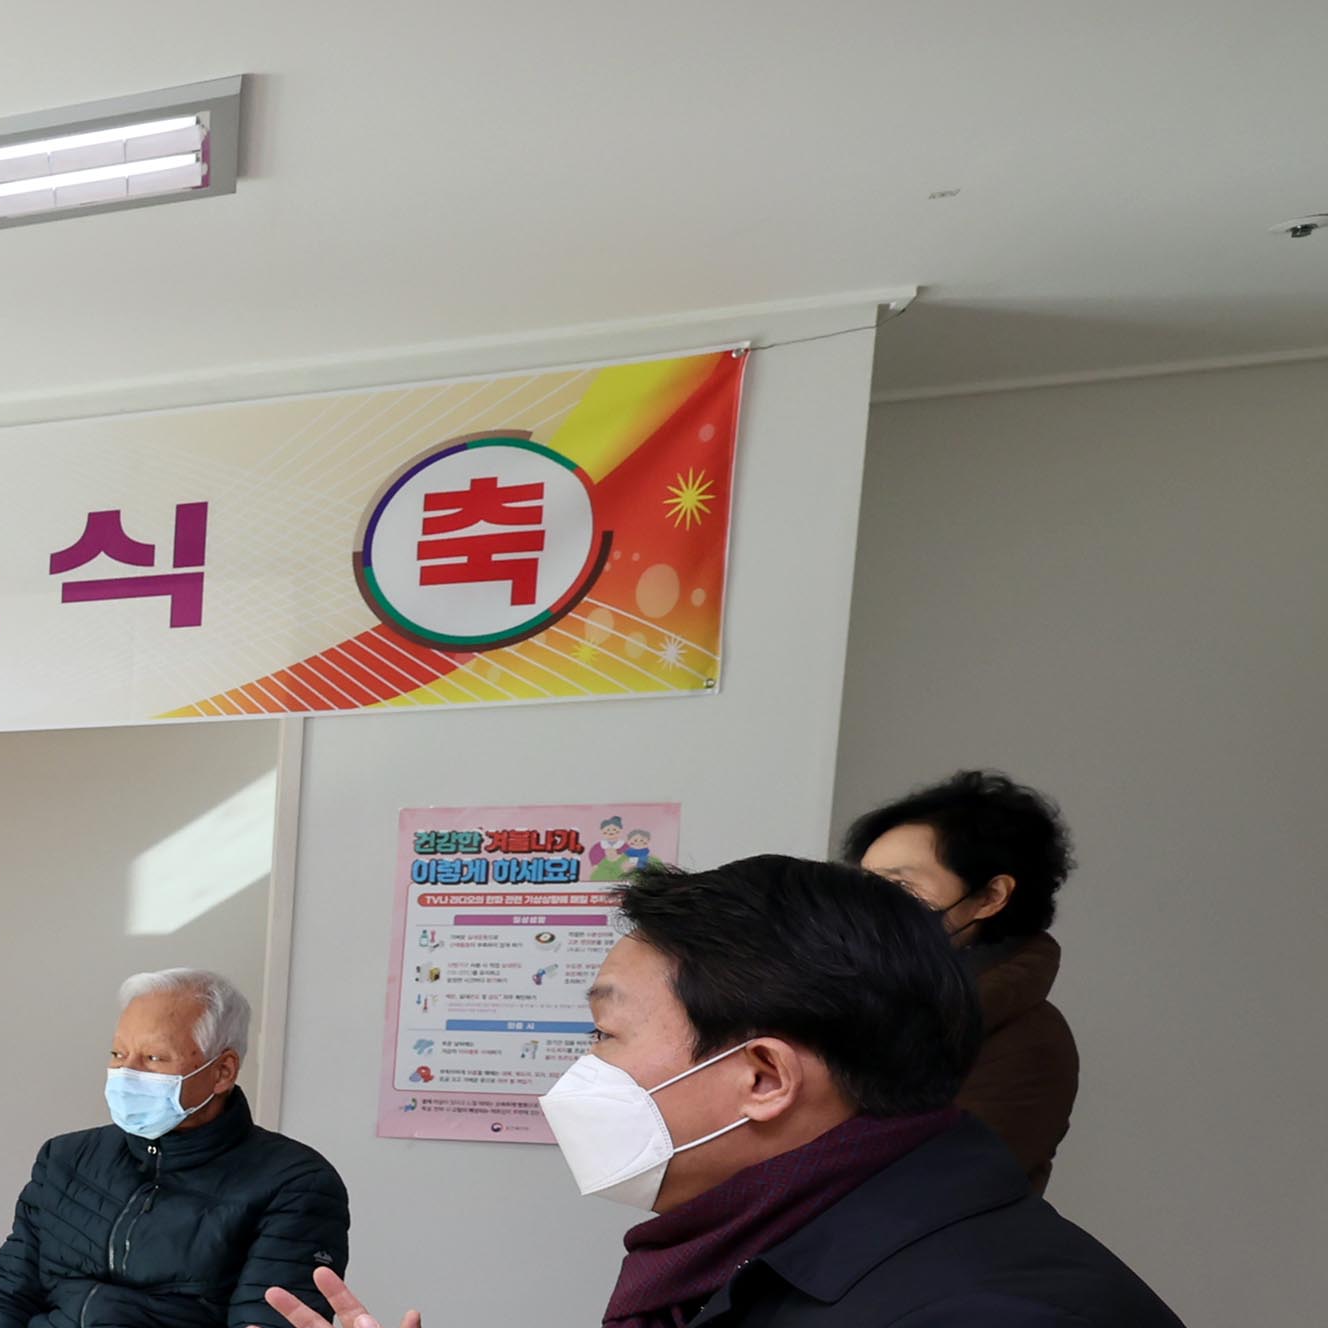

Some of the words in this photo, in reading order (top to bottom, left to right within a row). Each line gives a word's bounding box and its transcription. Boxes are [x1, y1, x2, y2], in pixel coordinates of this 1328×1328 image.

[417, 476, 546, 606] 축
[414, 829, 484, 854] 건강한
[411, 857, 490, 884] 이렇게
[493, 857, 580, 884] 하세요!
